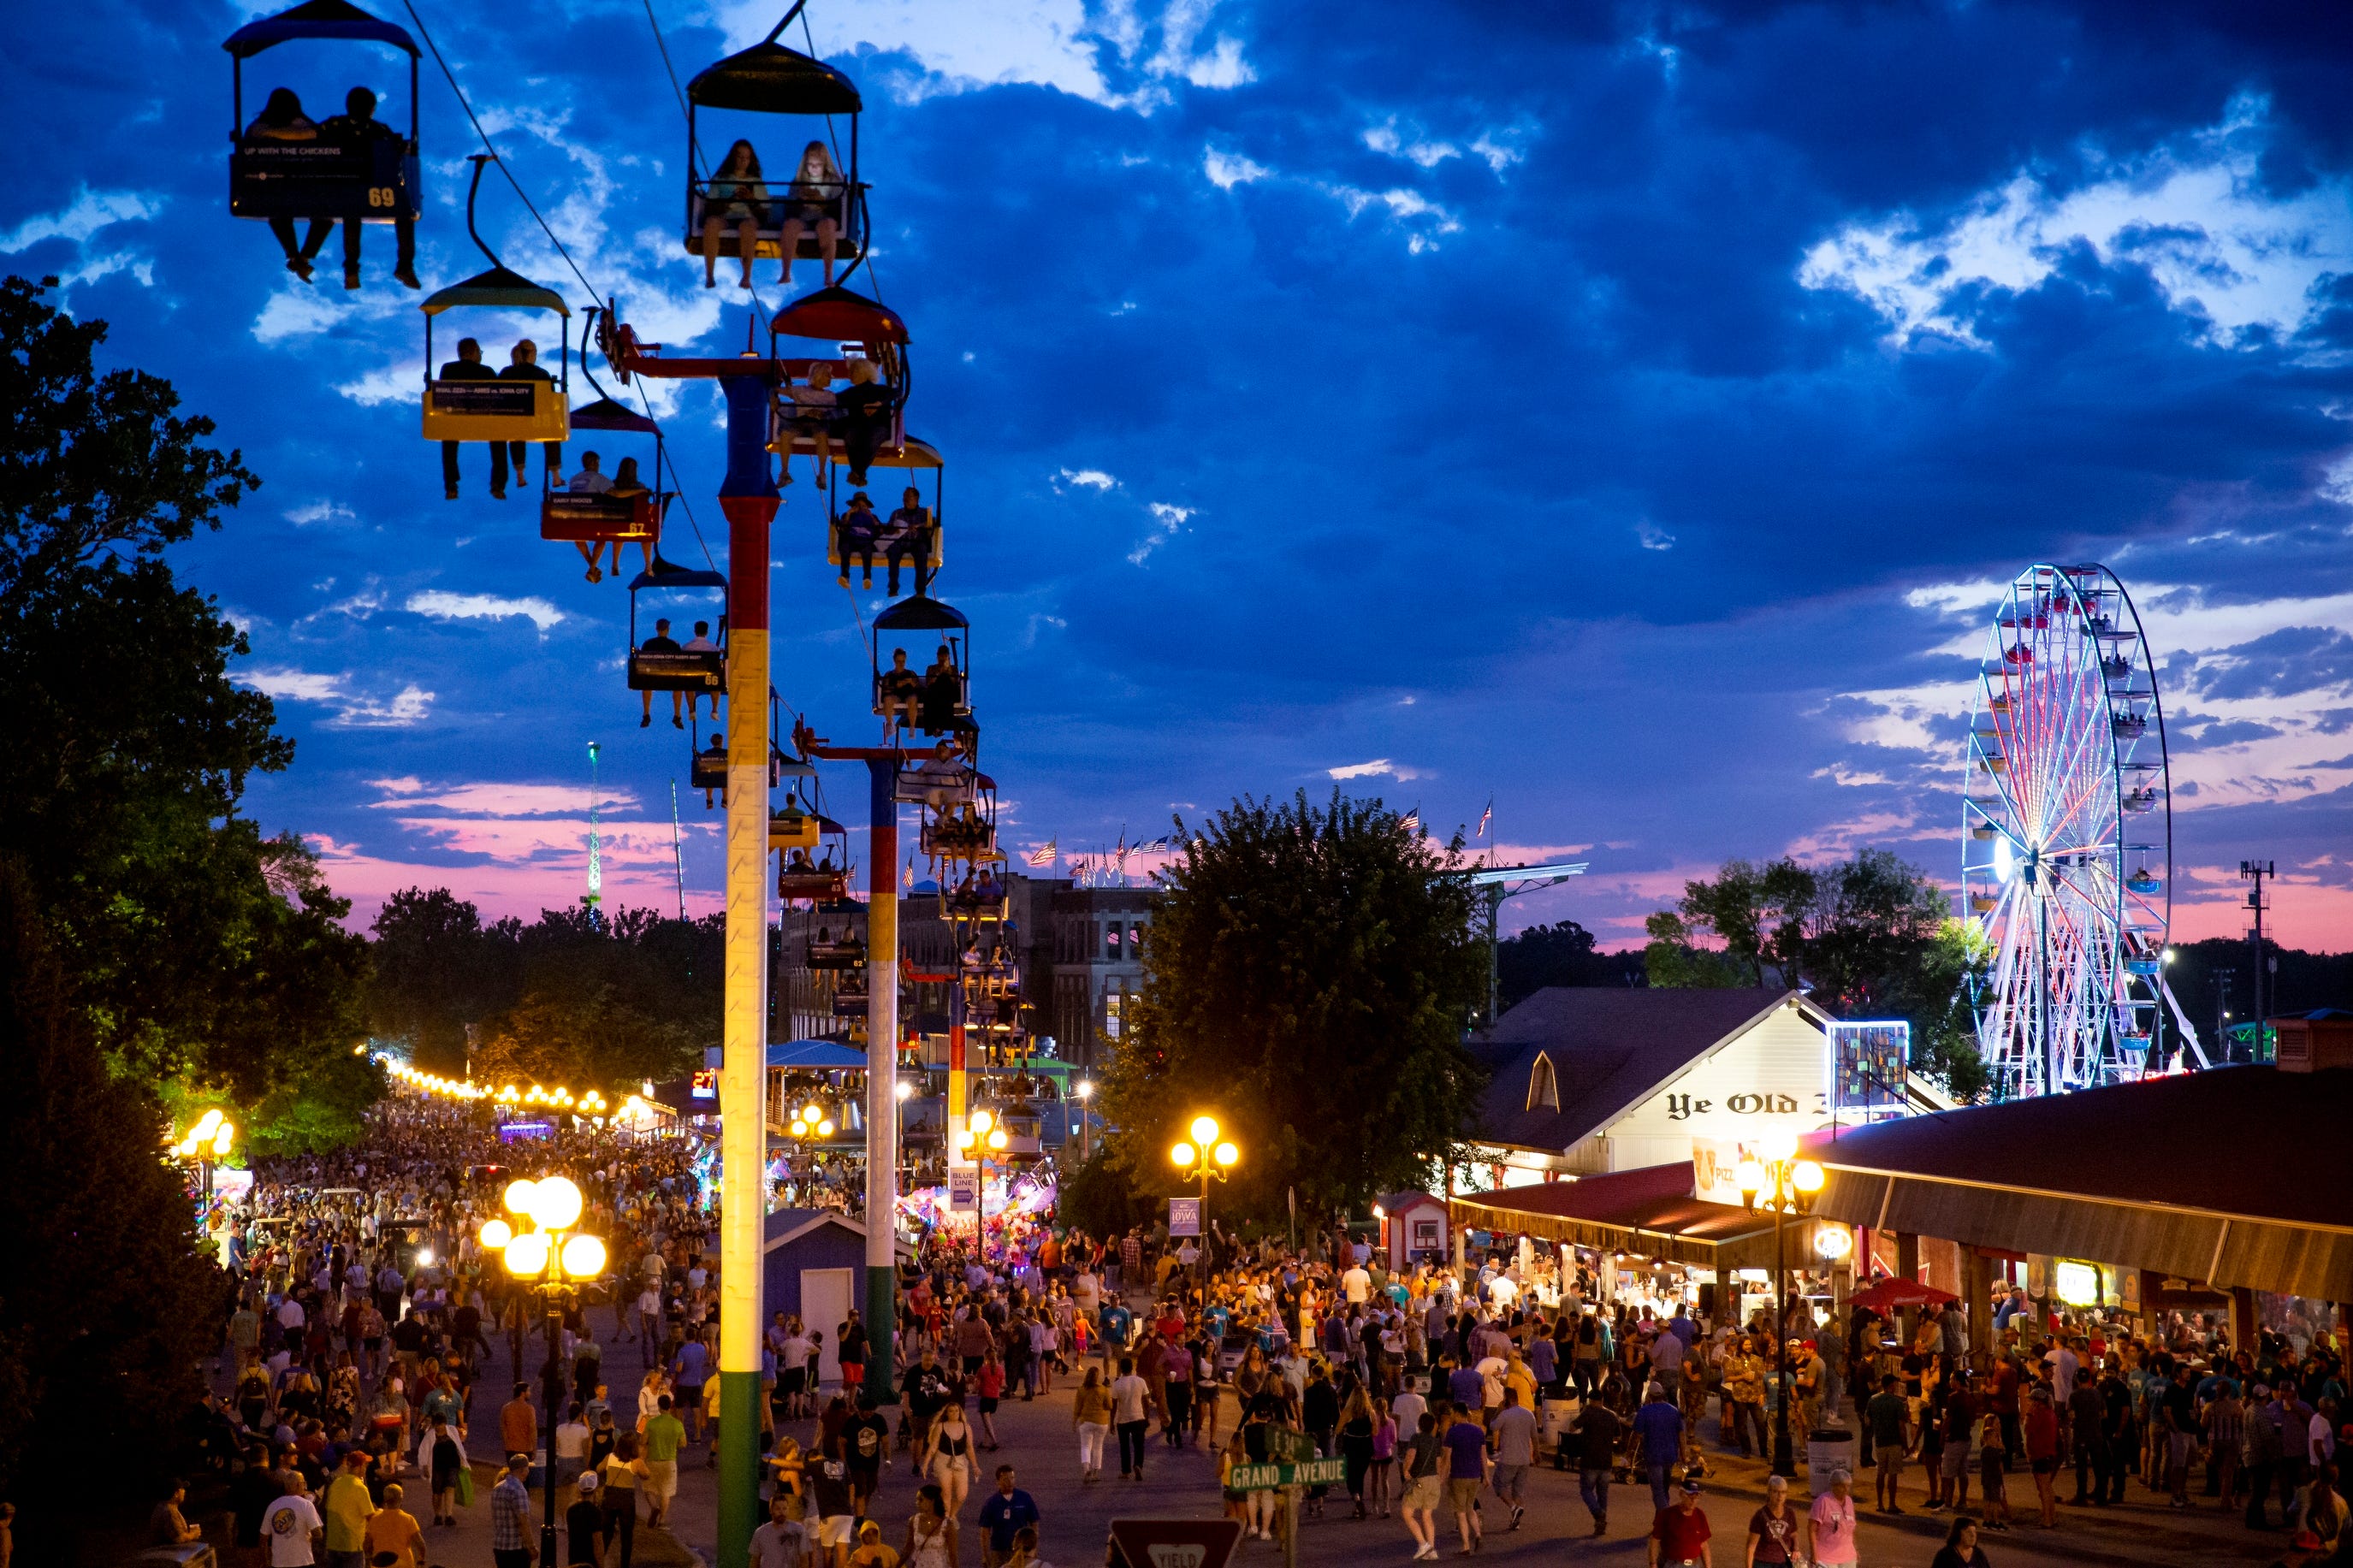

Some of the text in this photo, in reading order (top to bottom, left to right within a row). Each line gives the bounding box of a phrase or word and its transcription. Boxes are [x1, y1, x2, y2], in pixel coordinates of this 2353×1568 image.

[244, 147, 341, 156] UP WITH THE CHICKENS
[368, 187, 394, 207] 69
[629, 523, 644, 533] 67
[705, 675, 719, 685] 66
[1667, 1093, 1713, 1120] Ye
[1727, 1093, 1798, 1114] Old
[1716, 1166, 1735, 1181] PIZZ
[1172, 1211, 1197, 1221] IOWA
[1232, 1460, 1345, 1488] GRAND AVENUE
[1159, 1553, 1196, 1568] YIELD
